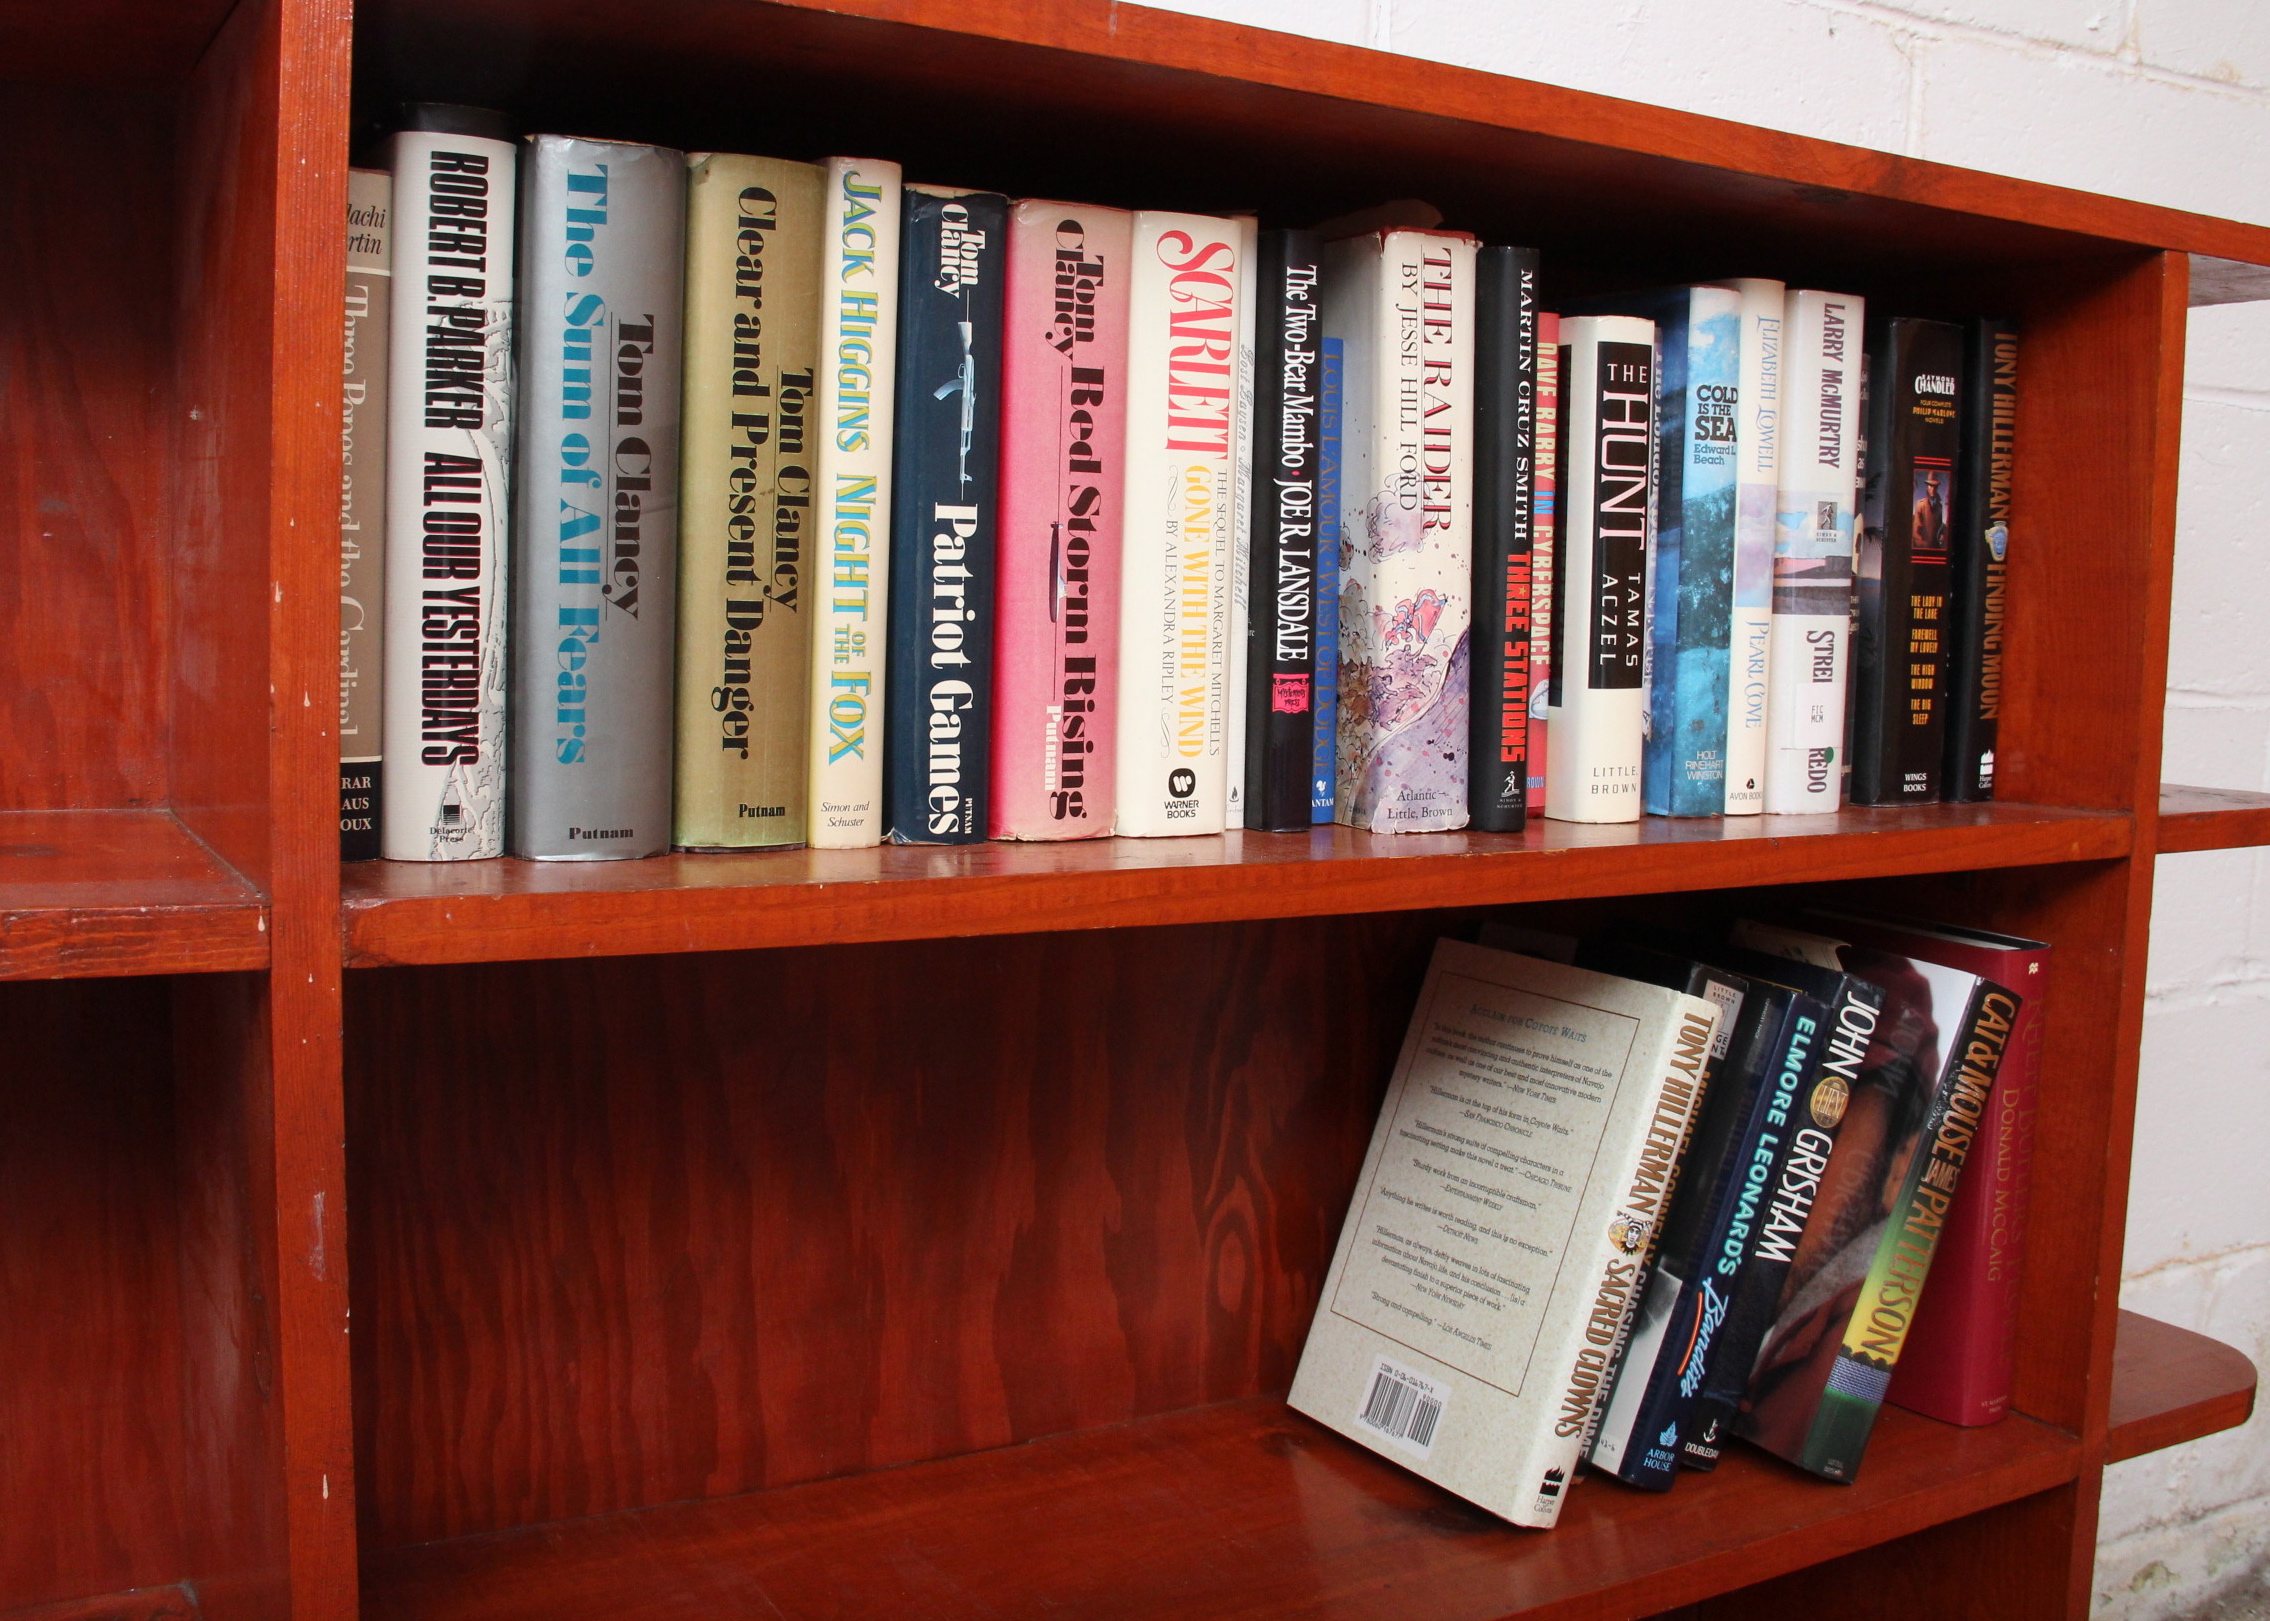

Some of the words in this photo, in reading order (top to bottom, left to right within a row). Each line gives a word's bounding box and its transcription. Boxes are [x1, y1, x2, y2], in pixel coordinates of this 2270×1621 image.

[428, 151, 489, 272] ROBERT
[565, 163, 608, 277] The
[735, 186, 777, 309] Clear
[842, 171, 882, 283] JACK
[427, 275, 486, 301] B.
[934, 203, 969, 299] Clancy
[960, 230, 986, 285] Tom
[1286, 264, 1317, 300] The
[1401, 263, 1418, 296] BY
[1045, 219, 1085, 362] Clancy
[1075, 255, 1104, 343] Tom
[1423, 248, 1453, 344] THE
[1518, 268, 1533, 374] MARTIN
[425, 306, 486, 429] PARKER
[562, 292, 606, 420] Sum
[733, 313, 770, 397] and
[1157, 230, 1236, 460] SCARLETT
[1282, 303, 1316, 393] Two-Bear
[1396, 303, 1418, 366] JESSE
[1536, 342, 1557, 396] DAVE
[1757, 315, 1780, 400] ELIZABETH
[1823, 303, 1845, 362] LARRY
[617, 313, 654, 427] Tom
[837, 290, 878, 453] HIGGINS
[1322, 353, 1339, 428] LOUIS
[1400, 377, 1418, 431] HILL
[1607, 363, 1647, 383] THE
[1696, 384, 1738, 404] COLD
[1914, 375, 1955, 395] CHANDLER
[1921, 374, 1955, 383] RAYMOND
[779, 368, 814, 454] Tom
[1068, 364, 1104, 474] Red
[1281, 393, 1314, 468] Mambo
[1422, 356, 1453, 533] RAIDER
[1516, 380, 1531, 448] CRUZ
[1534, 407, 1556, 480] BARRY
[1694, 415, 1737, 442] SEA
[1697, 403, 1709, 415] IS
[1711, 404, 1731, 416] THE
[1756, 404, 1777, 473] LOWELL
[1819, 368, 1843, 469] McMURTRY
[424, 452, 482, 506] ALL
[561, 433, 602, 488] of
[1217, 469, 1228, 498] THE
[1399, 441, 1417, 511] FORD
[1599, 390, 1648, 551] HUNT
[1693, 454, 1724, 465] Beach
[1989, 393, 2015, 519] HILLERMAN
[602, 437, 652, 620] Clancy
[726, 411, 770, 586] Present
[1166, 520, 1178, 538] BY
[1184, 465, 1213, 542] GONE
[1213, 502, 1227, 556] SEQUEL
[1235, 457, 1251, 534] Margaret
[1273, 478, 1312, 518] JOE
[1320, 436, 1338, 553] L'AMOUR
[1513, 457, 1529, 540] SMITH
[1534, 491, 1555, 514] IN
[423, 511, 481, 579] OUR
[560, 498, 601, 585] All
[763, 465, 811, 613] Clancy
[833, 474, 877, 622] NIGHT
[1066, 485, 1102, 645] Storm
[1279, 522, 1312, 544] R.
[930, 502, 978, 669] Patriot
[1162, 542, 1178, 645] ALEXANDRA
[1181, 550, 1210, 620] WITH
[1214, 563, 1225, 581] TO
[1234, 536, 1249, 611] Mitchell
[1276, 548, 1311, 661] LANSDALE
[1318, 570, 1337, 639] WEST
[1505, 551, 1531, 632] THREE
[1531, 526, 1553, 665] CYBERSPACE
[1983, 563, 2007, 650] FINDING
[834, 624, 850, 664] THE
[851, 631, 866, 657] OF
[1180, 624, 1208, 678] THE
[1211, 586, 1223, 668] MARGARET
[1600, 574, 1618, 666] ACZEL
[1625, 572, 1640, 667] TAMAS
[1746, 621, 1770, 678] PEARL
[422, 586, 480, 766] YESTERDAYS
[557, 603, 600, 764] Fears
[711, 598, 764, 759] Danger
[1161, 651, 1175, 704] RIPLEY
[1316, 645, 1334, 679] OF
[1980, 654, 2001, 720] MOON
[829, 671, 871, 766] FOX
[1050, 654, 1097, 820] Rising
[1178, 685, 1206, 757] WIND
[1210, 672, 1222, 755] MITCHELL'S
[1314, 685, 1334, 776] DODGE
[1501, 641, 1528, 763] STATIONS
[1744, 682, 1766, 728] COVE
[1811, 705, 1824, 714] FIC
[1811, 714, 1824, 722] MCM
[928, 679, 974, 834] Games
[1045, 705, 1062, 792] Putnam
[1685, 760, 1724, 770] RINEHART
[1687, 770, 1723, 780] WINSTON
[1696, 750, 1717, 760] HOLT
[1904, 773, 1927, 782] WINGS
[738, 803, 785, 818] Putnam
[821, 801, 850, 812] Simon
[853, 801, 870, 811] and
[827, 816, 864, 827] Schuster
[964, 797, 973, 835] PUTNAM
[1164, 800, 1199, 809] WARNER
[1167, 809, 1196, 819] BOOKS
[1387, 807, 1418, 820] Little,
[1421, 806, 1453, 818] Brown
[1591, 783, 1637, 794] BROWN
[1903, 784, 1927, 792] BOOKS
[430, 827, 473, 838] Delacorte
[568, 827, 633, 840] Putnam
[1712, 991, 1735, 1004] BROWN
[1822, 989, 1881, 1080] JOHN
[1975, 991, 2017, 1043] CAT
[1669, 1012, 1714, 1080] TONY
[1766, 1015, 1817, 1128] ELMORE
[1965, 1040, 2000, 1070] &
[1626, 1077, 1694, 1216] HILLERMAN
[1931, 1064, 1997, 1166] MOUSE
[1996, 1088, 2021, 1182] DONALD
[1715, 1133, 1780, 1277] LEONARD'S
[1754, 1127, 1834, 1263] GRISHAM
[1921, 1156, 1962, 1192] JAMES
[1585, 1258, 1635, 1347] SACRED
[1860, 1184, 1952, 1361] PATTERSON
[1380, 1363, 1393, 1374] ISBN
[1680, 1276, 1729, 1398] Bandits
[1554, 1348, 1606, 1439] CLOWNS
[1643, 1457, 1672, 1472] HOUSE
[1646, 1448, 1676, 1463] ARBOR
[1684, 1442, 1720, 1459] DOUBLEDAY
